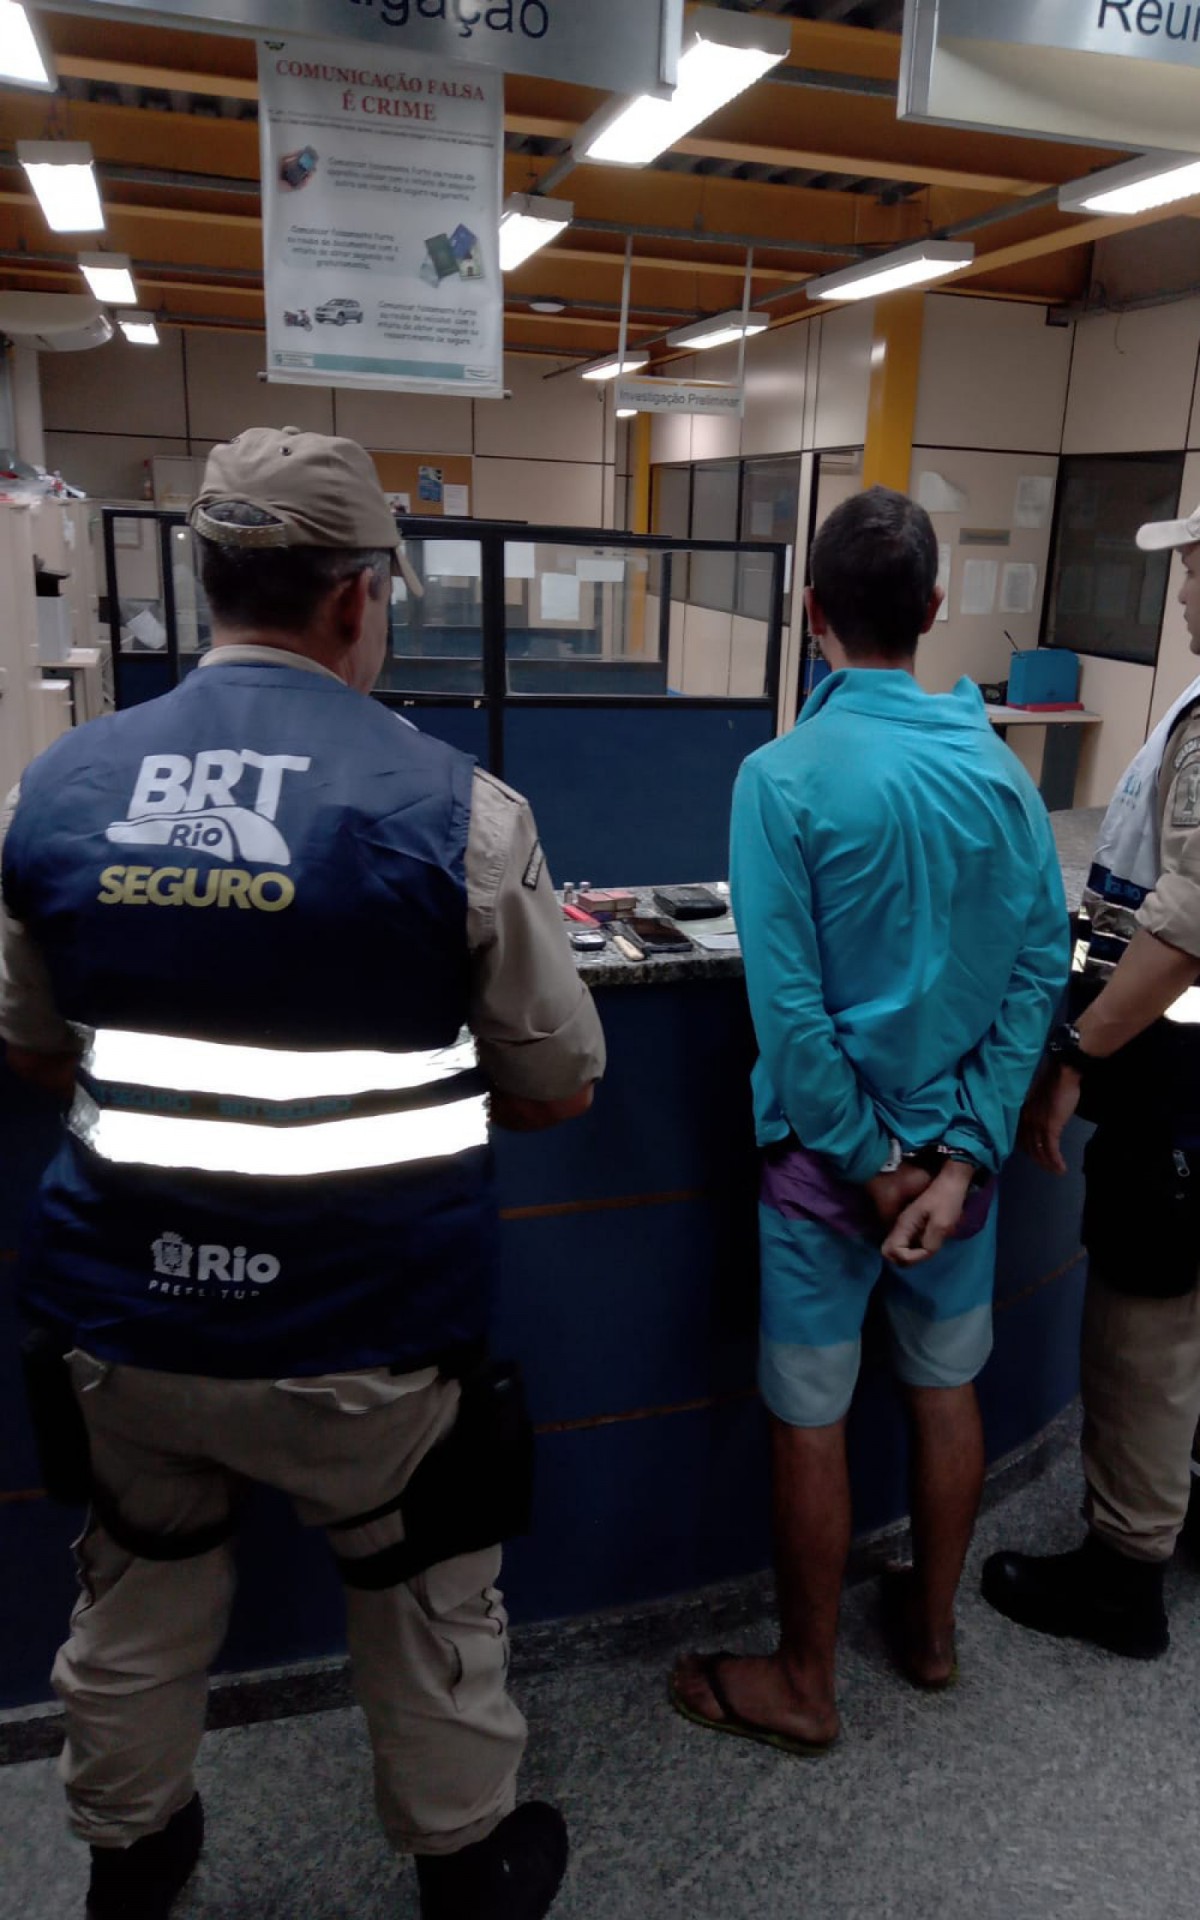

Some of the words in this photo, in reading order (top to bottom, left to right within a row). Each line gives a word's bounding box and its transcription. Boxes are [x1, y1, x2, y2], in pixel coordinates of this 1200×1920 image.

[1098, 0, 1200, 42] Reu
[275, 59, 423, 93] COMUNICAÇÃO
[427, 78, 485, 101] FALSA
[341, 89, 356, 111] É
[361, 94, 437, 121] CRIME
[127, 749, 312, 821] BRT
[168, 822, 223, 847] Rio
[97, 864, 295, 912] SEGURO
[197, 1244, 281, 1283] Rio
